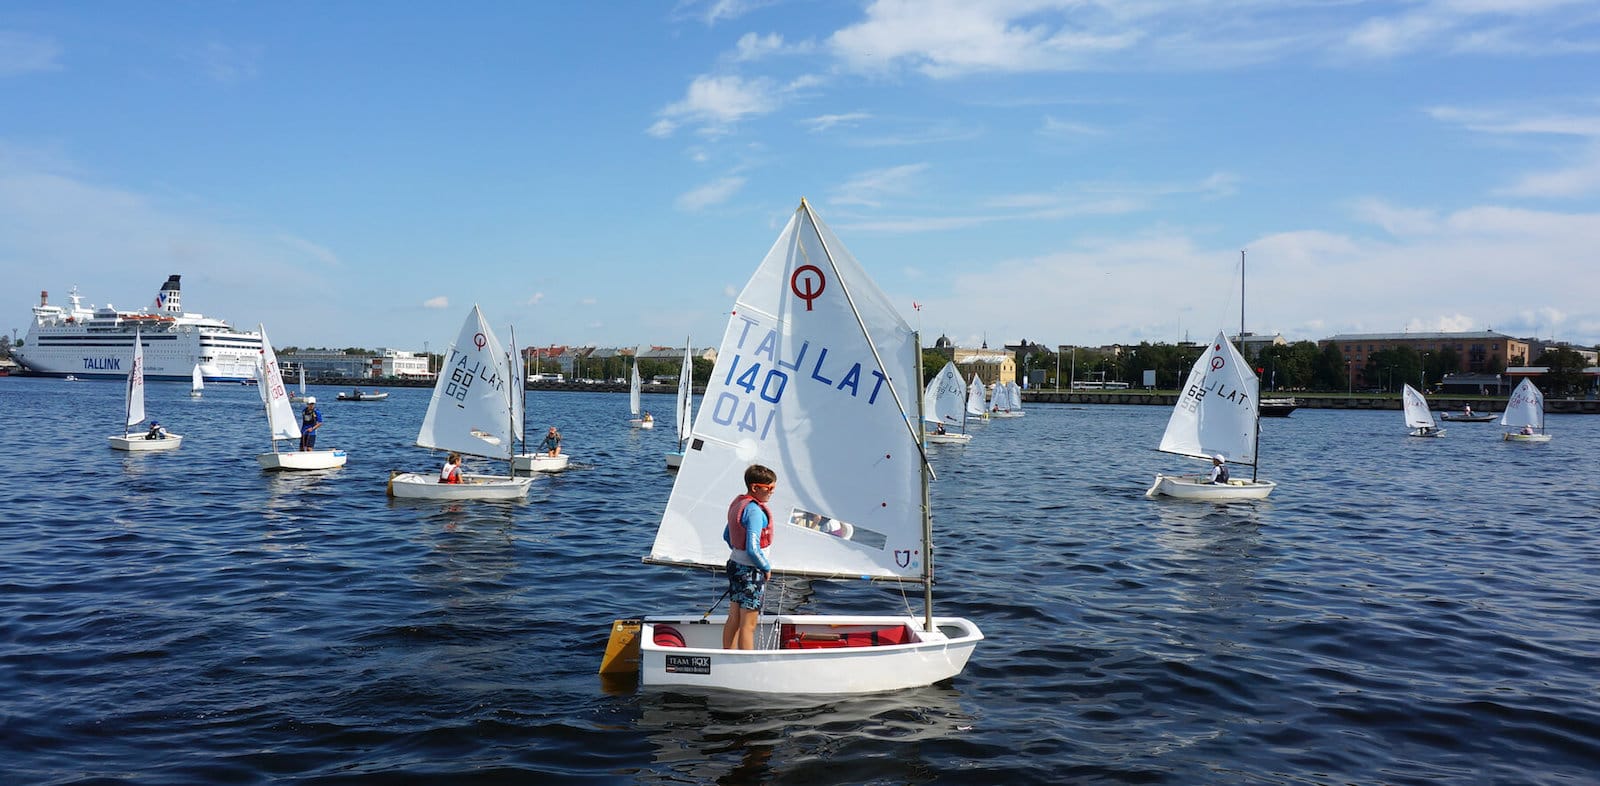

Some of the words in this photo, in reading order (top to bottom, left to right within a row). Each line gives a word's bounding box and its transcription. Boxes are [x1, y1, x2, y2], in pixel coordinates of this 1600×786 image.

[83, 358, 120, 370] TALLINK
[452, 368, 474, 388] 60
[480, 366, 504, 391] LAT
[724, 354, 788, 404] 140
[811, 348, 891, 405] LAT
[1188, 384, 1207, 402] 62
[1217, 384, 1248, 405] LAT
[670, 657, 689, 665] TEAM
